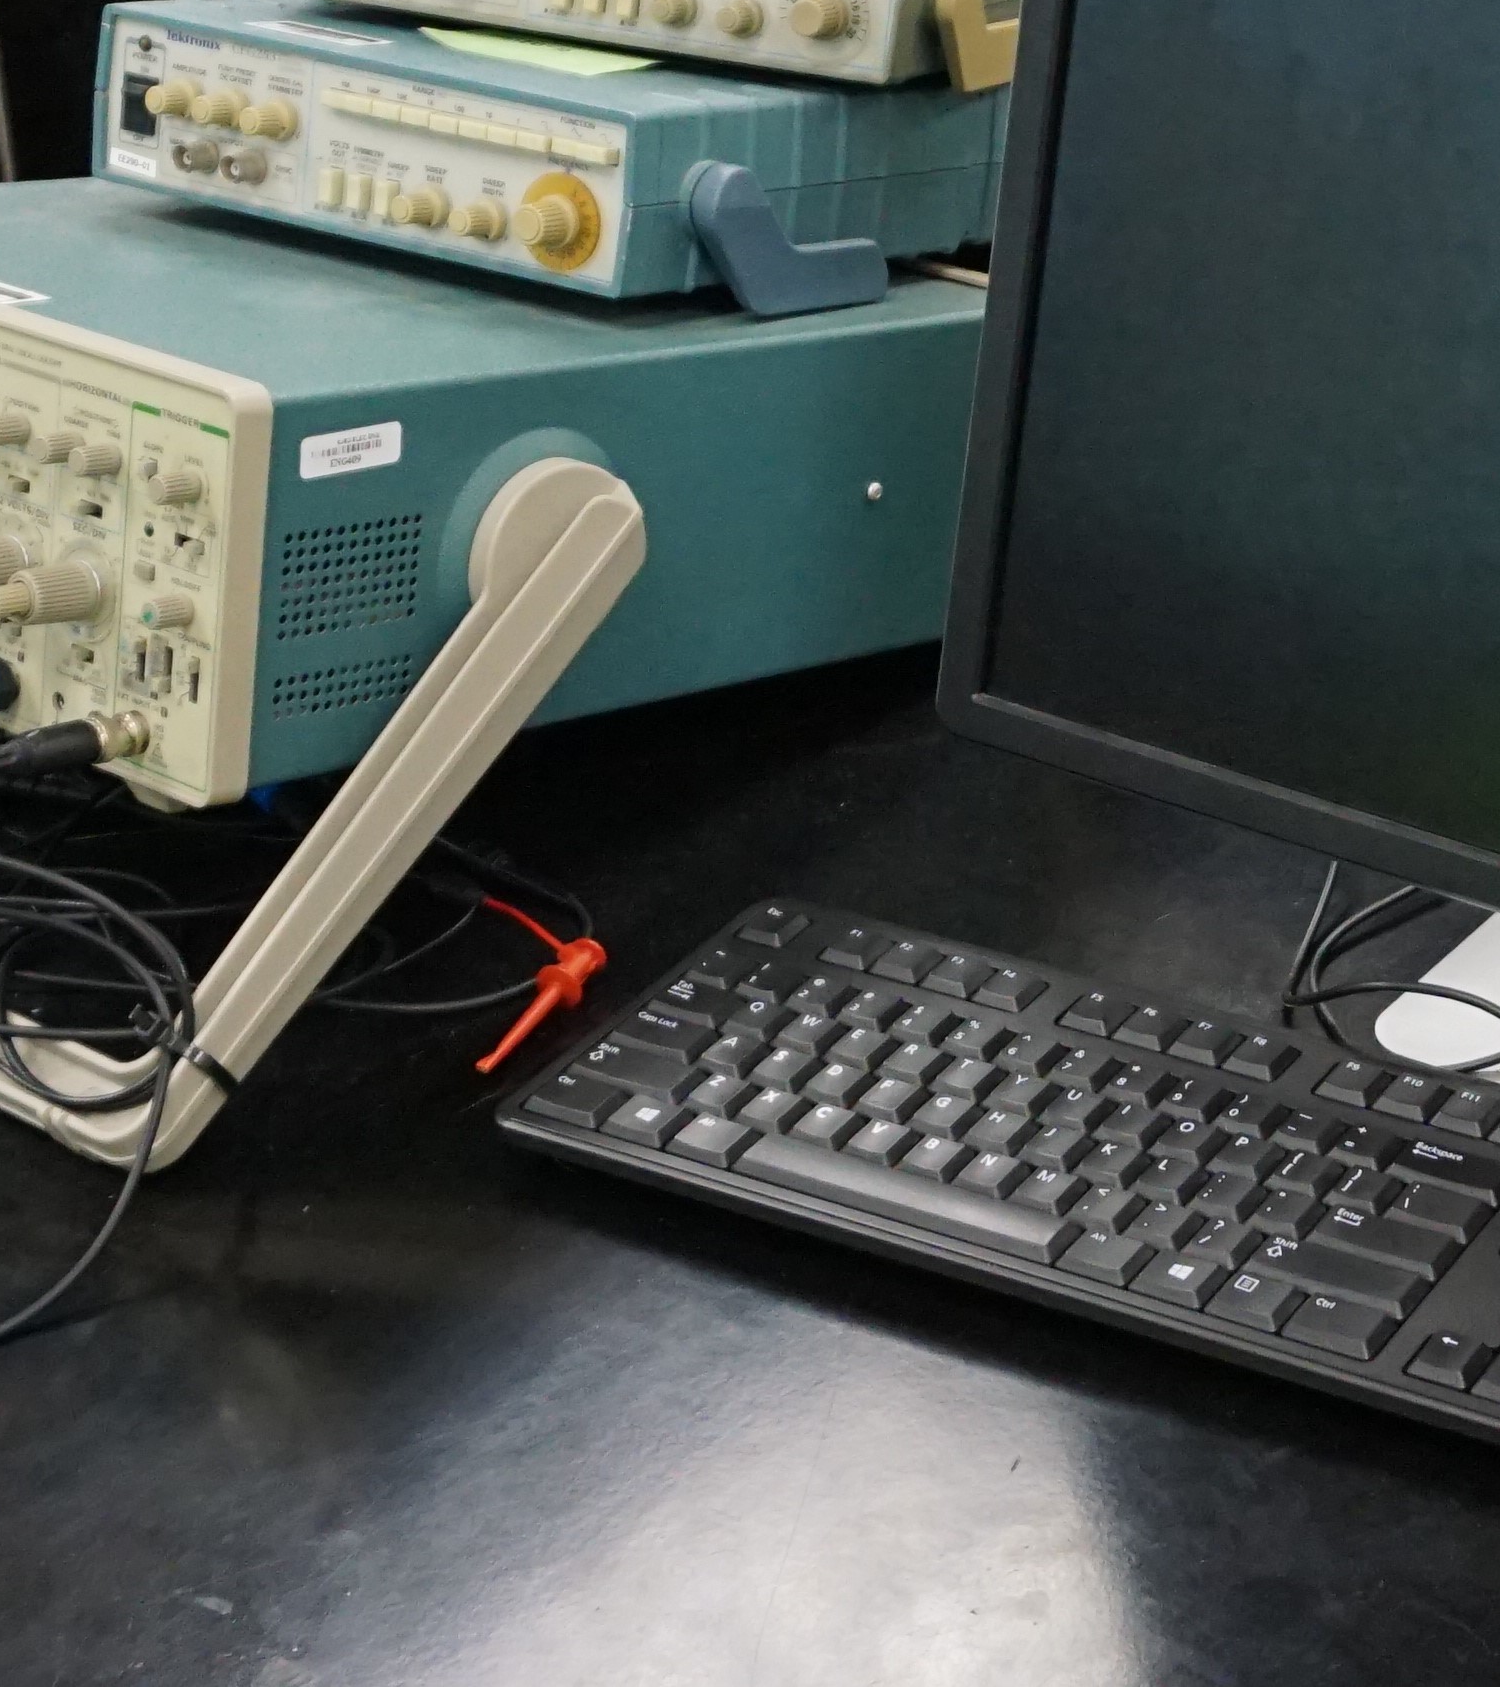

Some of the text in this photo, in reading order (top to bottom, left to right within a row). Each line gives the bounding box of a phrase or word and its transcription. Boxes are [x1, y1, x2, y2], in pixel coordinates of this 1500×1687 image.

[160, 407, 200, 428] TRIGGER
[850, 928, 864, 938] F1
[951, 955, 966, 965] F3
[797, 989, 810, 998] 2
[750, 1001, 765, 1013] Q
[849, 1002, 861, 1012] 3
[638, 1011, 679, 1029] Caps Lock
[802, 1014, 822, 1027] W
[901, 1017, 913, 1026] 4
[1198, 1021, 1213, 1031] F7
[851, 1028, 867, 1040] E
[953, 1031, 966, 1041] 5
[722, 1036, 739, 1048] A
[598, 1042, 621, 1055] Shift
[903, 1043, 919, 1055] R
[1007, 1046, 1018, 1056] 6
[773, 1050, 790, 1061] S
[960, 1058, 974, 1069] T
[1061, 1061, 1073, 1070] 7
[826, 1064, 844, 1076] D
[558, 1075, 577, 1086] Ctrl
[708, 1075, 727, 1087] Z
[879, 1079, 896, 1090] F
[1015, 1074, 1029, 1085] Y
[1116, 1076, 1128, 1086] 8
[1403, 1076, 1425, 1088] F10
[761, 1089, 781, 1104] X
[1067, 1088, 1083, 1101] U
[1171, 1092, 1183, 1102] 9
[1460, 1090, 1482, 1103] F11
[935, 1096, 952, 1108] G
[815, 1106, 834, 1119] C
[1121, 1104, 1132, 1115] I
[1228, 1107, 1240, 1117] 0
[988, 1111, 1006, 1123] H
[871, 1122, 890, 1134] V
[1044, 1127, 1058, 1138] J
[1179, 1121, 1195, 1133] O
[923, 1137, 941, 1149] B
[1235, 1136, 1250, 1146] P
[1101, 1143, 1118, 1156] K
[1415, 1141, 1464, 1162] Backspace
[980, 1154, 999, 1166] N
[1158, 1159, 1169, 1171] L
[1036, 1169, 1057, 1183] M
[1336, 1207, 1365, 1222] Enter
[1090, 1231, 1107, 1243] Alt
[1273, 1236, 1299, 1251] Shift
[1315, 1297, 1337, 1310] Ctrl
